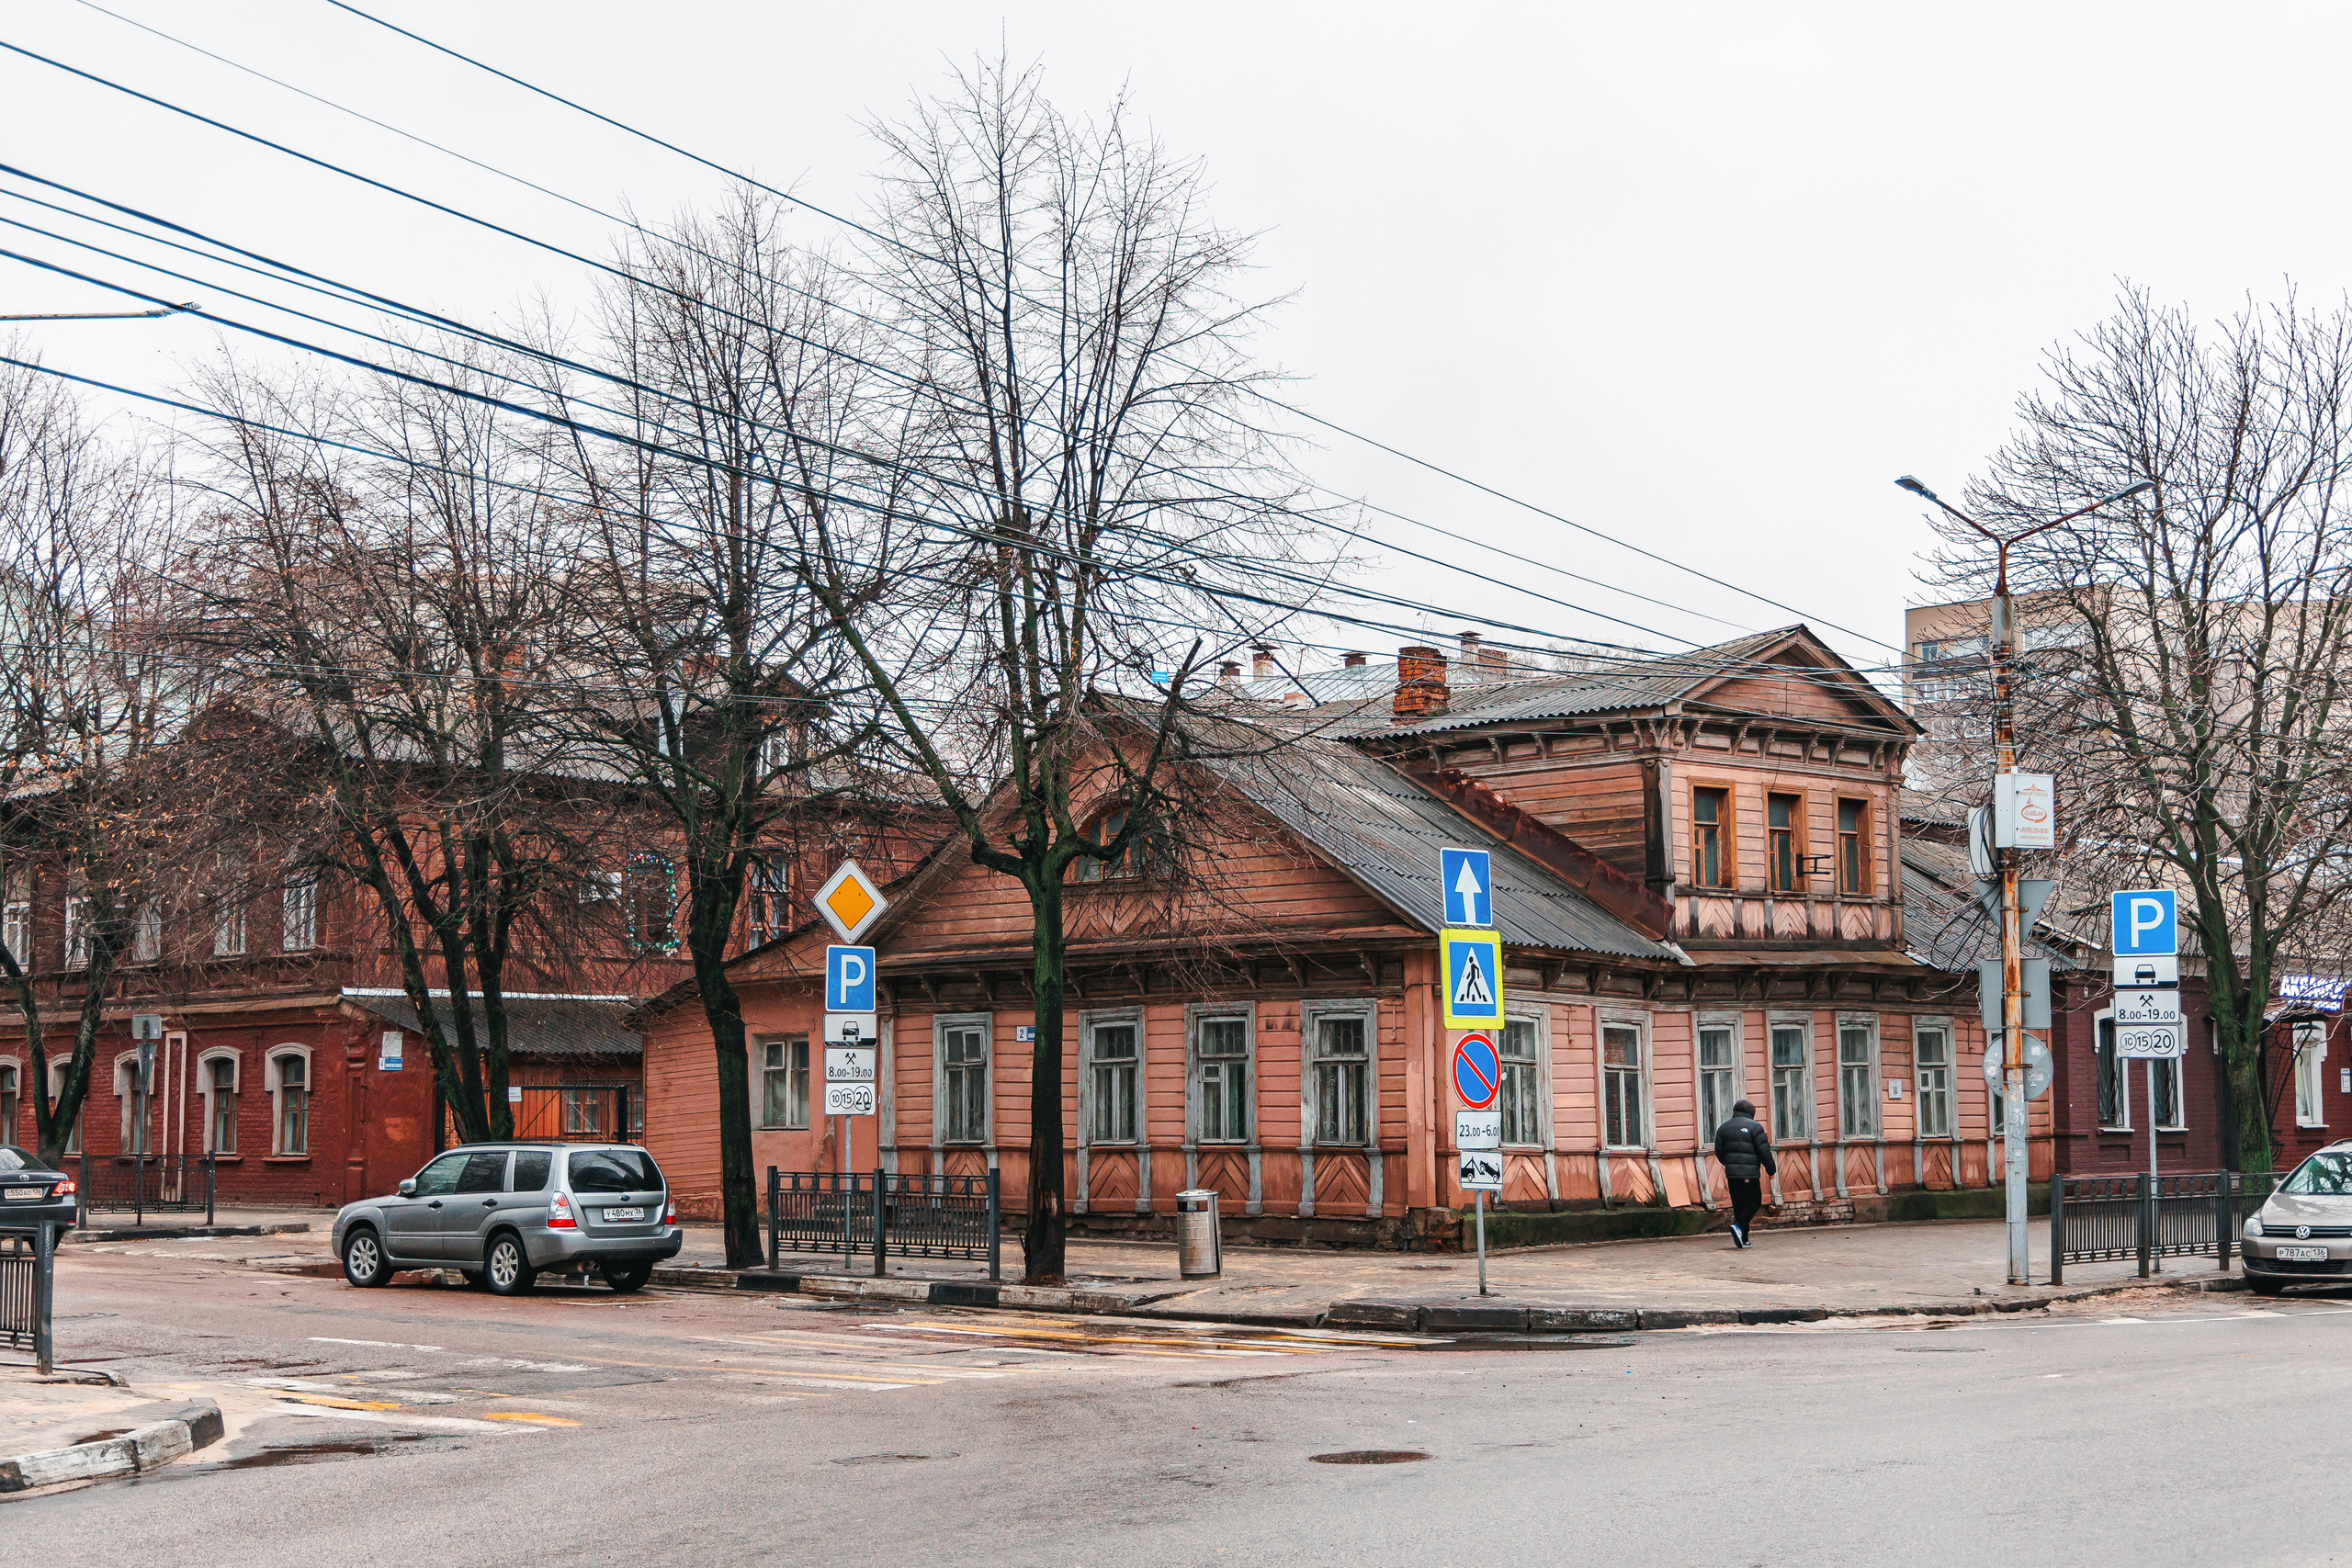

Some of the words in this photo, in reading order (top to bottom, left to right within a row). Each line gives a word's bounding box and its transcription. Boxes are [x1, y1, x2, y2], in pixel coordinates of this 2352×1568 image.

[2130, 897, 2165, 948] P
[840, 953, 866, 1004] P
[2119, 1009, 2176, 1020] 8.00-19.00
[1019, 1029, 1024, 1039] 2
[2136, 1035, 2149, 1047] 15
[2154, 1034, 2172, 1049] 20
[828, 1066, 873, 1077] 8.00-19.00
[831, 1094, 840, 1103] 10
[842, 1093, 853, 1104] 15
[855, 1091, 870, 1105] 20
